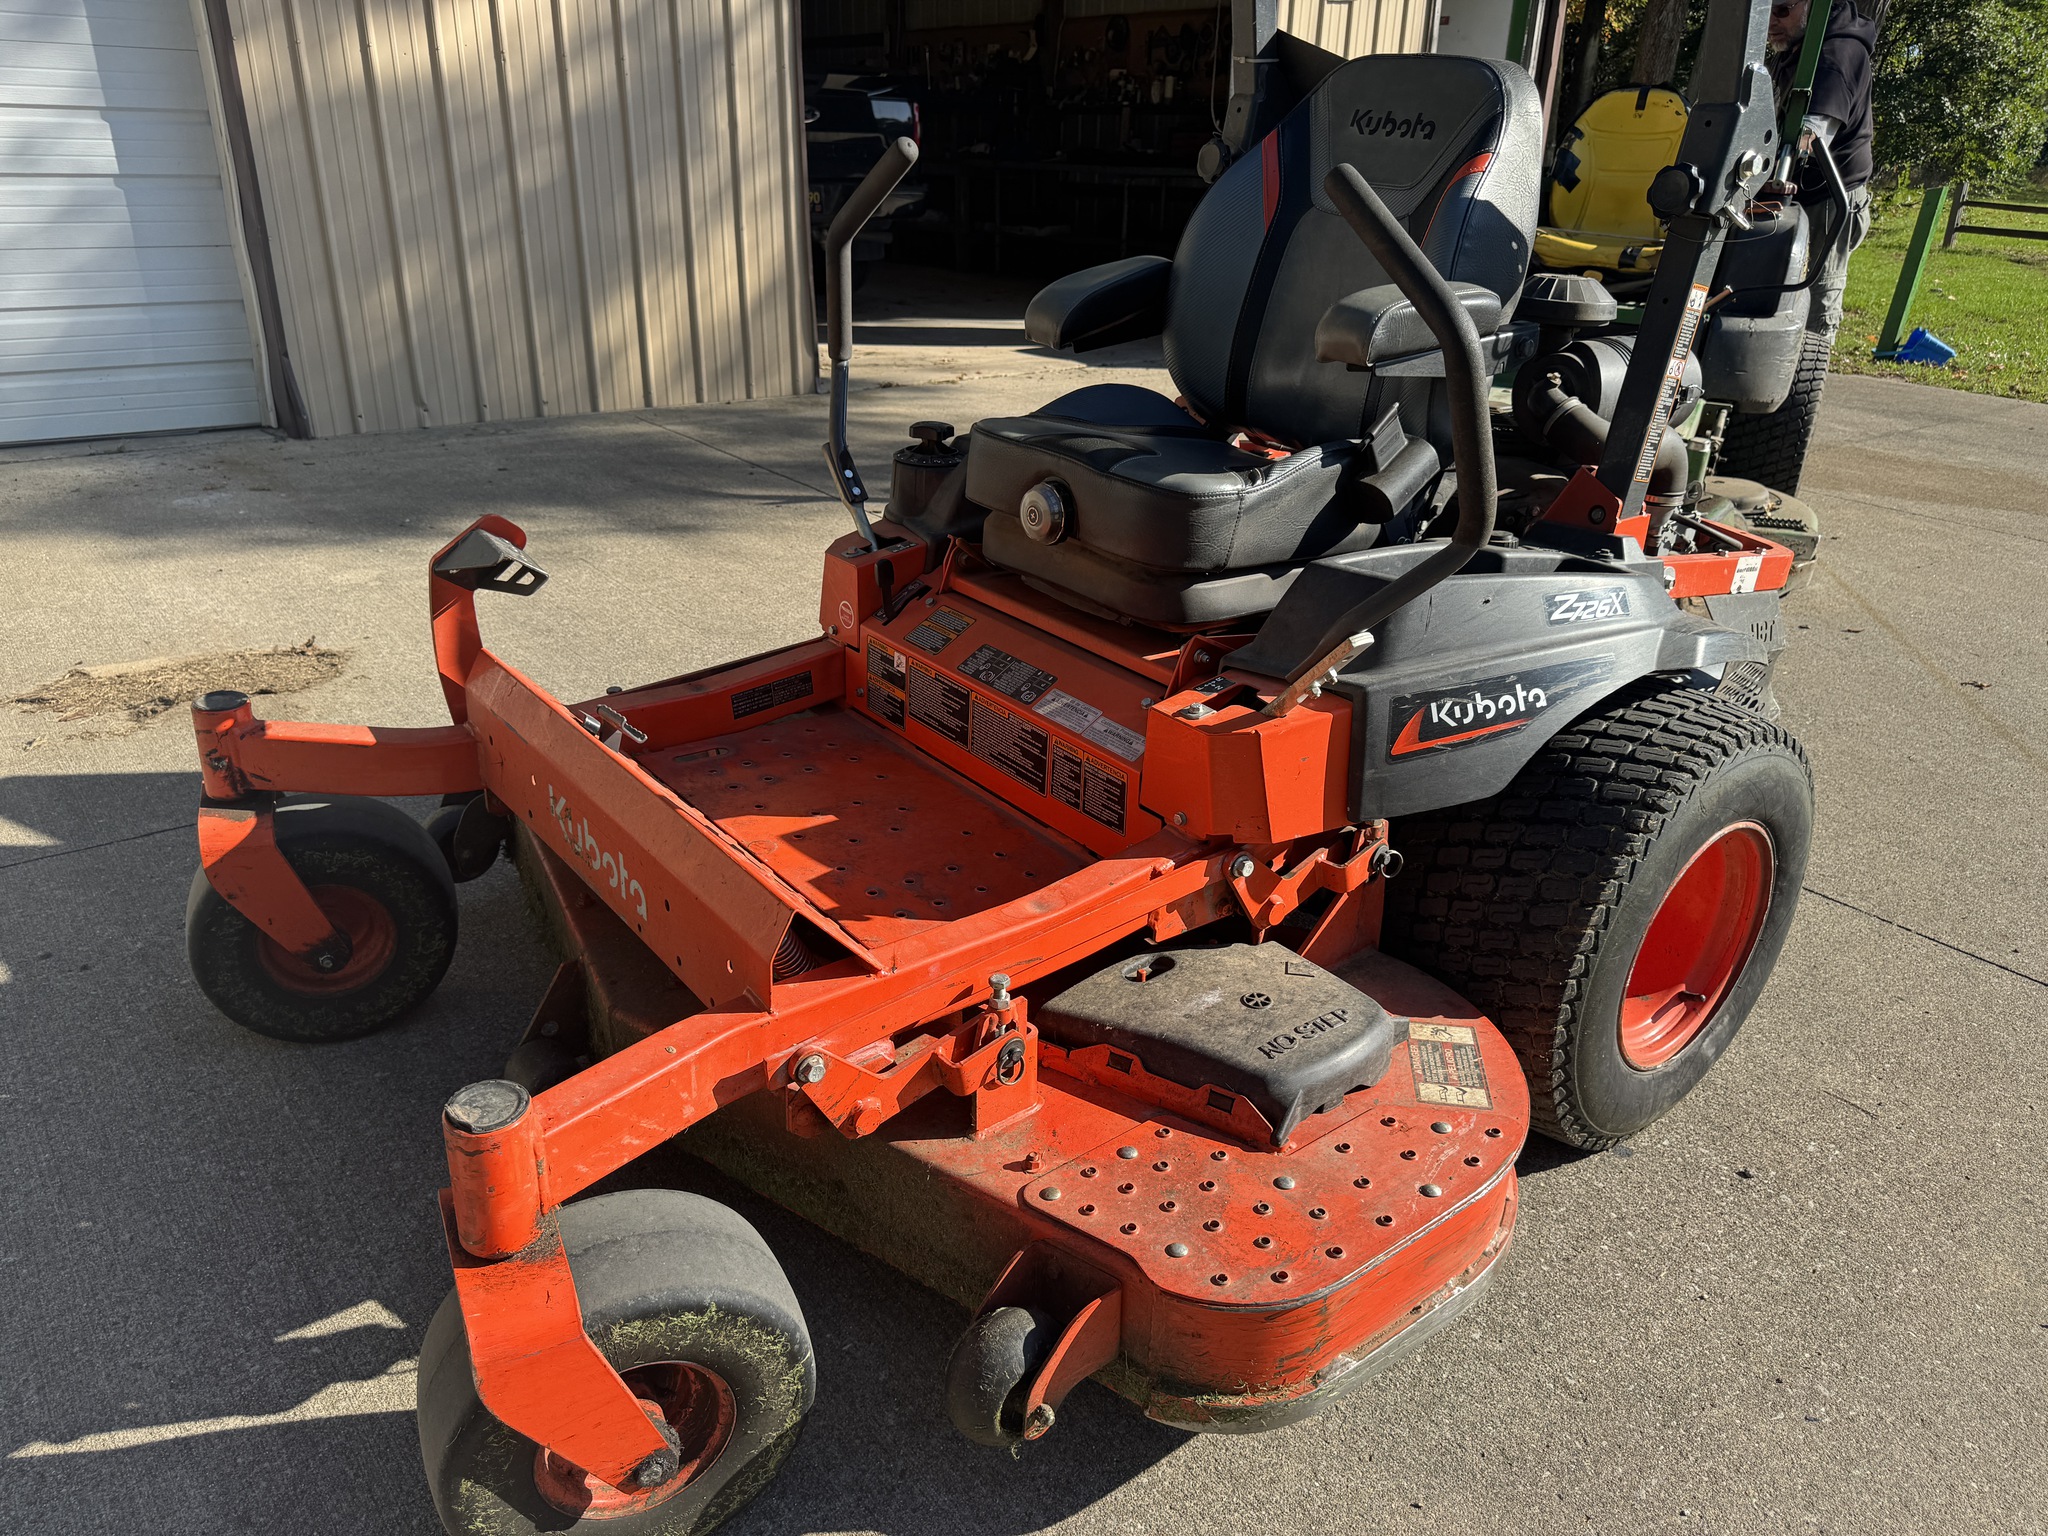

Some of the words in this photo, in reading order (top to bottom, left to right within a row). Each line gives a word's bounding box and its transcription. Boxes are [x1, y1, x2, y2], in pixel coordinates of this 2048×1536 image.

[1350, 109, 1436, 140] Kubota
[1550, 591, 1626, 622] Z726X
[979, 695, 1007, 716] ADVERTENCIA
[1430, 684, 1548, 727] Kubota
[1091, 757, 1125, 779] ADVERTENCIA
[548, 784, 648, 921] Kubota
[1257, 1033, 1299, 1060] NO
[1294, 1008, 1348, 1039] STEP
[1410, 1044, 1422, 1070] DANGER
[1444, 1048, 1458, 1075] PELIGRO
